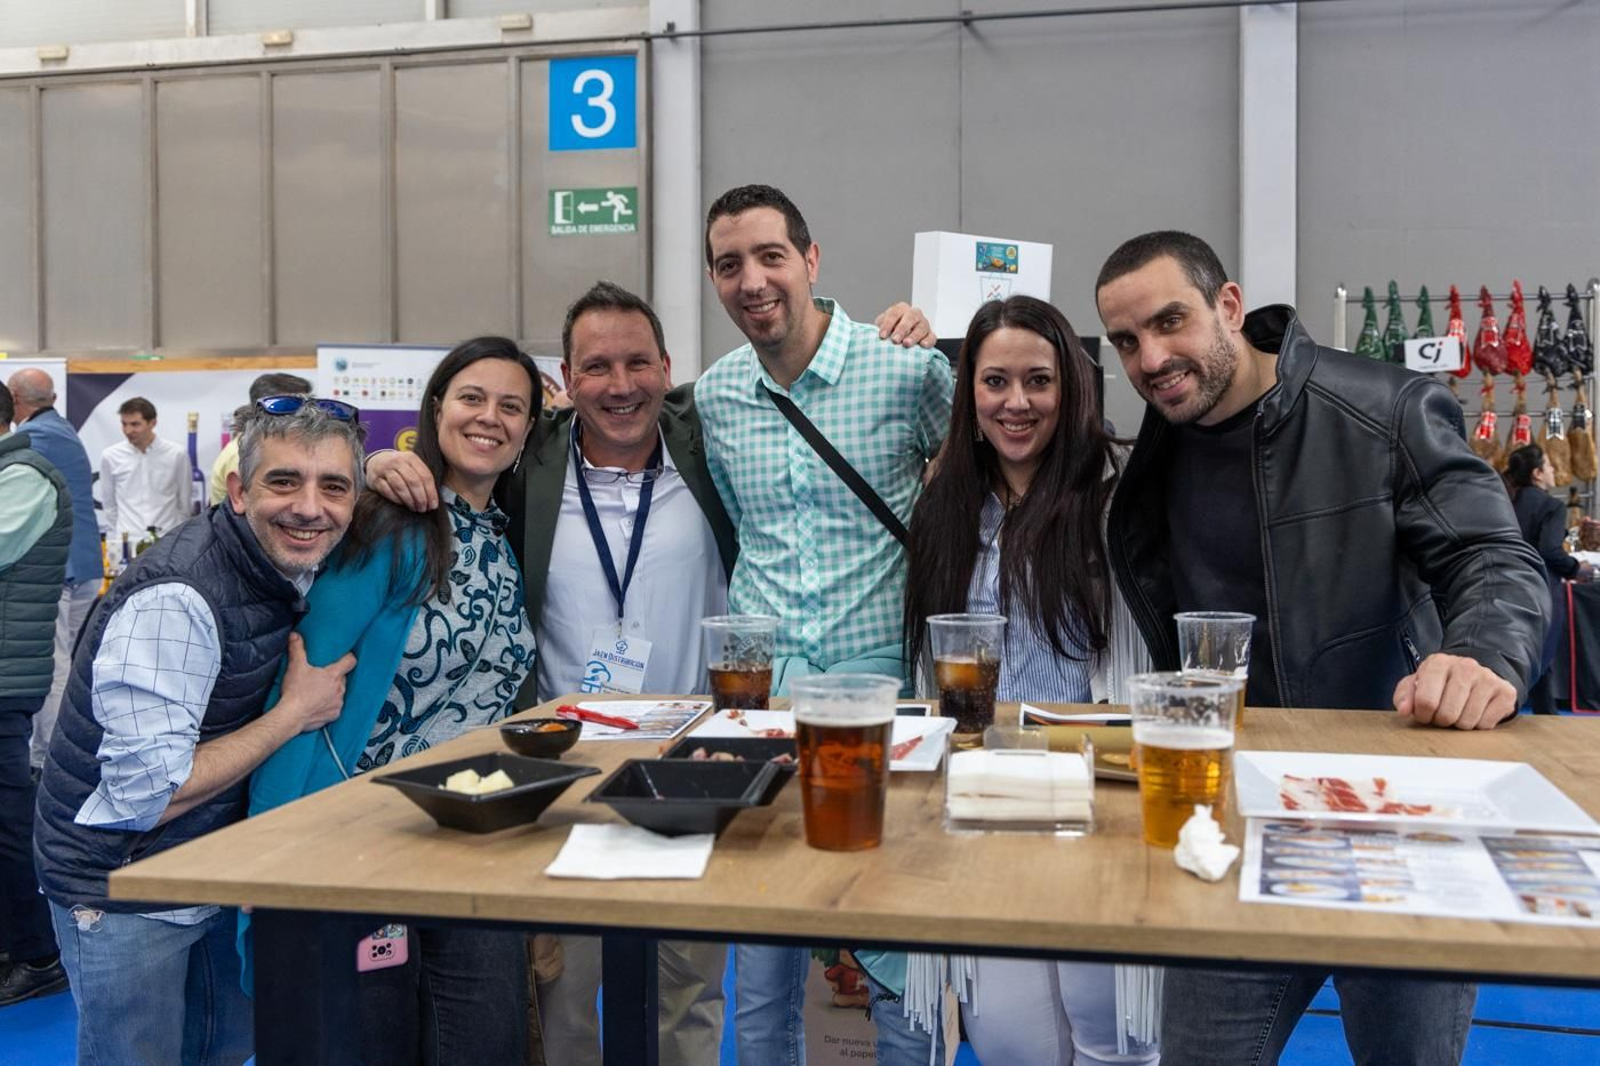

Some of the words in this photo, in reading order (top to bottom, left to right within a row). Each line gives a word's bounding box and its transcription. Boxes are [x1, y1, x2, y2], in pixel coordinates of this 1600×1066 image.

[571, 69, 616, 138] 3
[551, 224, 577, 235] SALIDA
[578, 224, 588, 234] DE
[589, 223, 636, 233] EMERGENCIA
